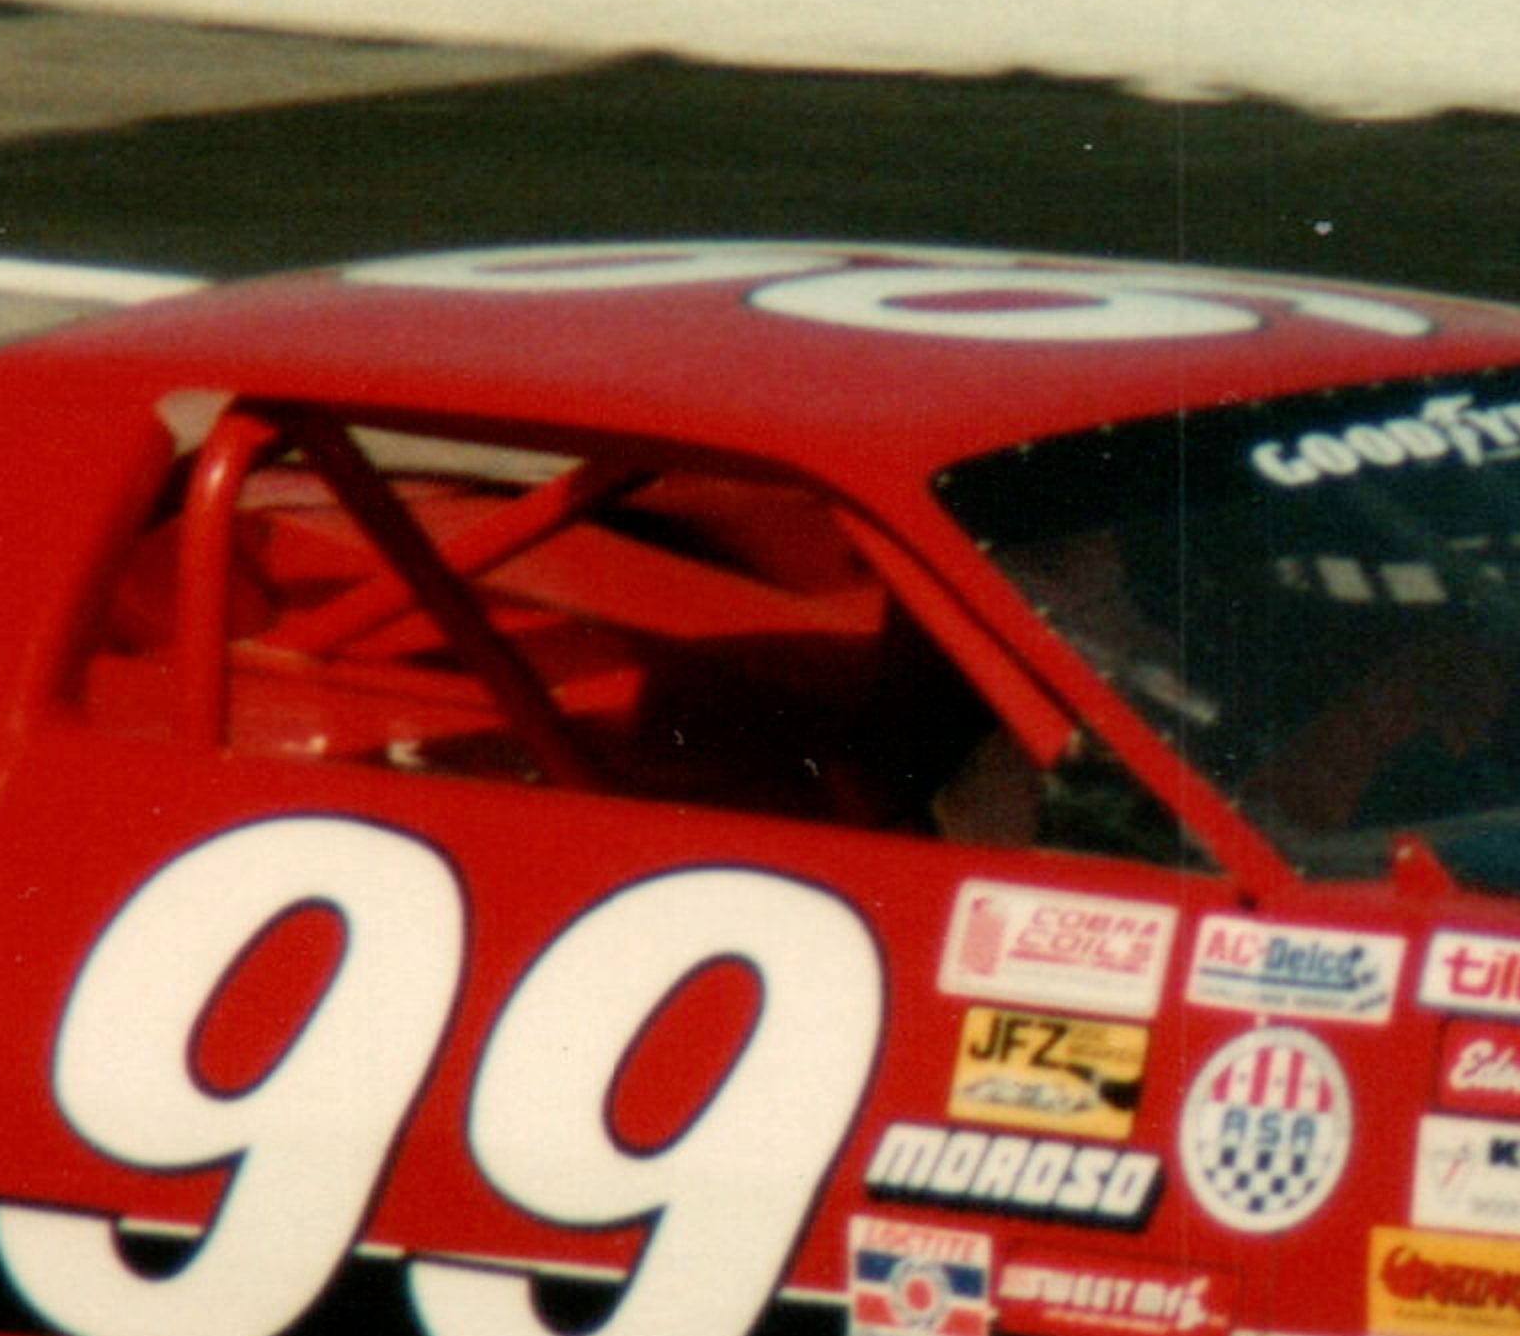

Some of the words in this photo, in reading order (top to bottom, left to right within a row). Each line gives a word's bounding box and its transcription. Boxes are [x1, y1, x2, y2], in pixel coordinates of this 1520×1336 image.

[1015, 927, 1152, 964] COILS
[1032, 906, 1160, 937] COBRA
[969, 1014, 1070, 1069] JFZ
[1220, 1105, 1317, 1153] ASA
[864, 1122, 1162, 1221] MOROSO
